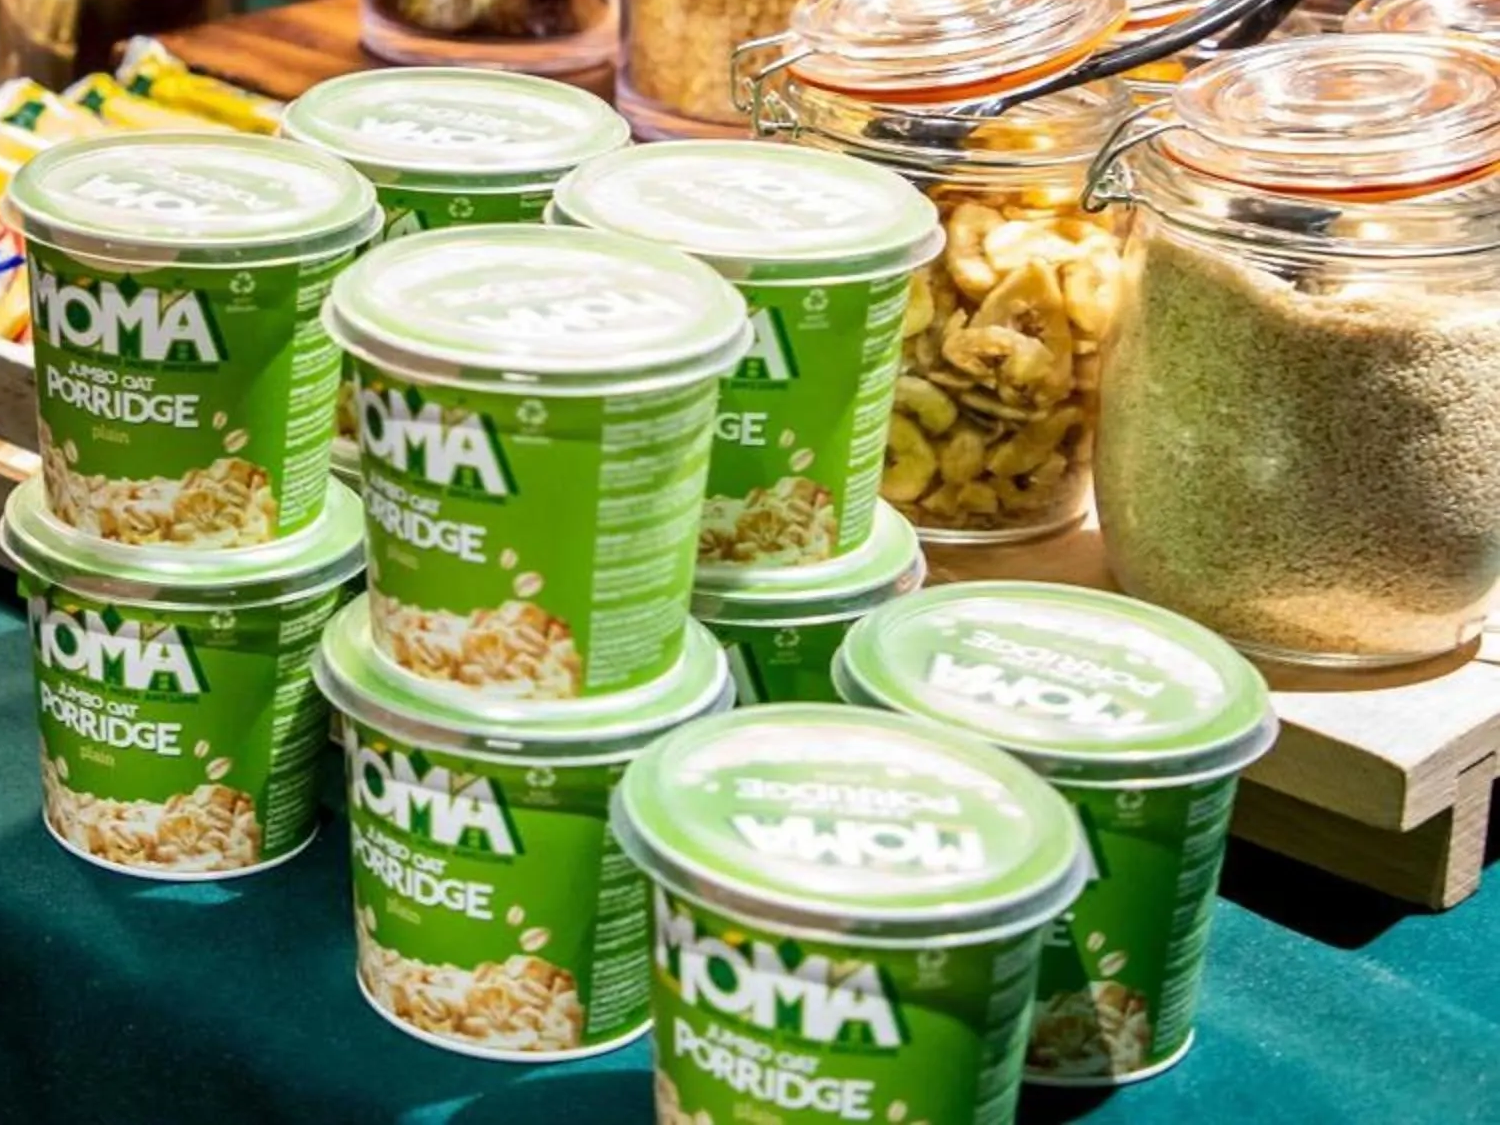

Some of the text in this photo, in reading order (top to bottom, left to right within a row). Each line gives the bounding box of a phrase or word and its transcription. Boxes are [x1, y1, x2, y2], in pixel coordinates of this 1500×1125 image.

[31, 259, 220, 362] MOMA
[47, 364, 200, 428] PORRIDGE
[68, 361, 119, 385] JUMBO
[121, 375, 156, 392] OAT
[358, 388, 508, 496] OMA
[40, 681, 182, 756] PORRIDGE
[655, 883, 902, 1047] MOMA
[674, 1017, 875, 1121] PORRIDGE
